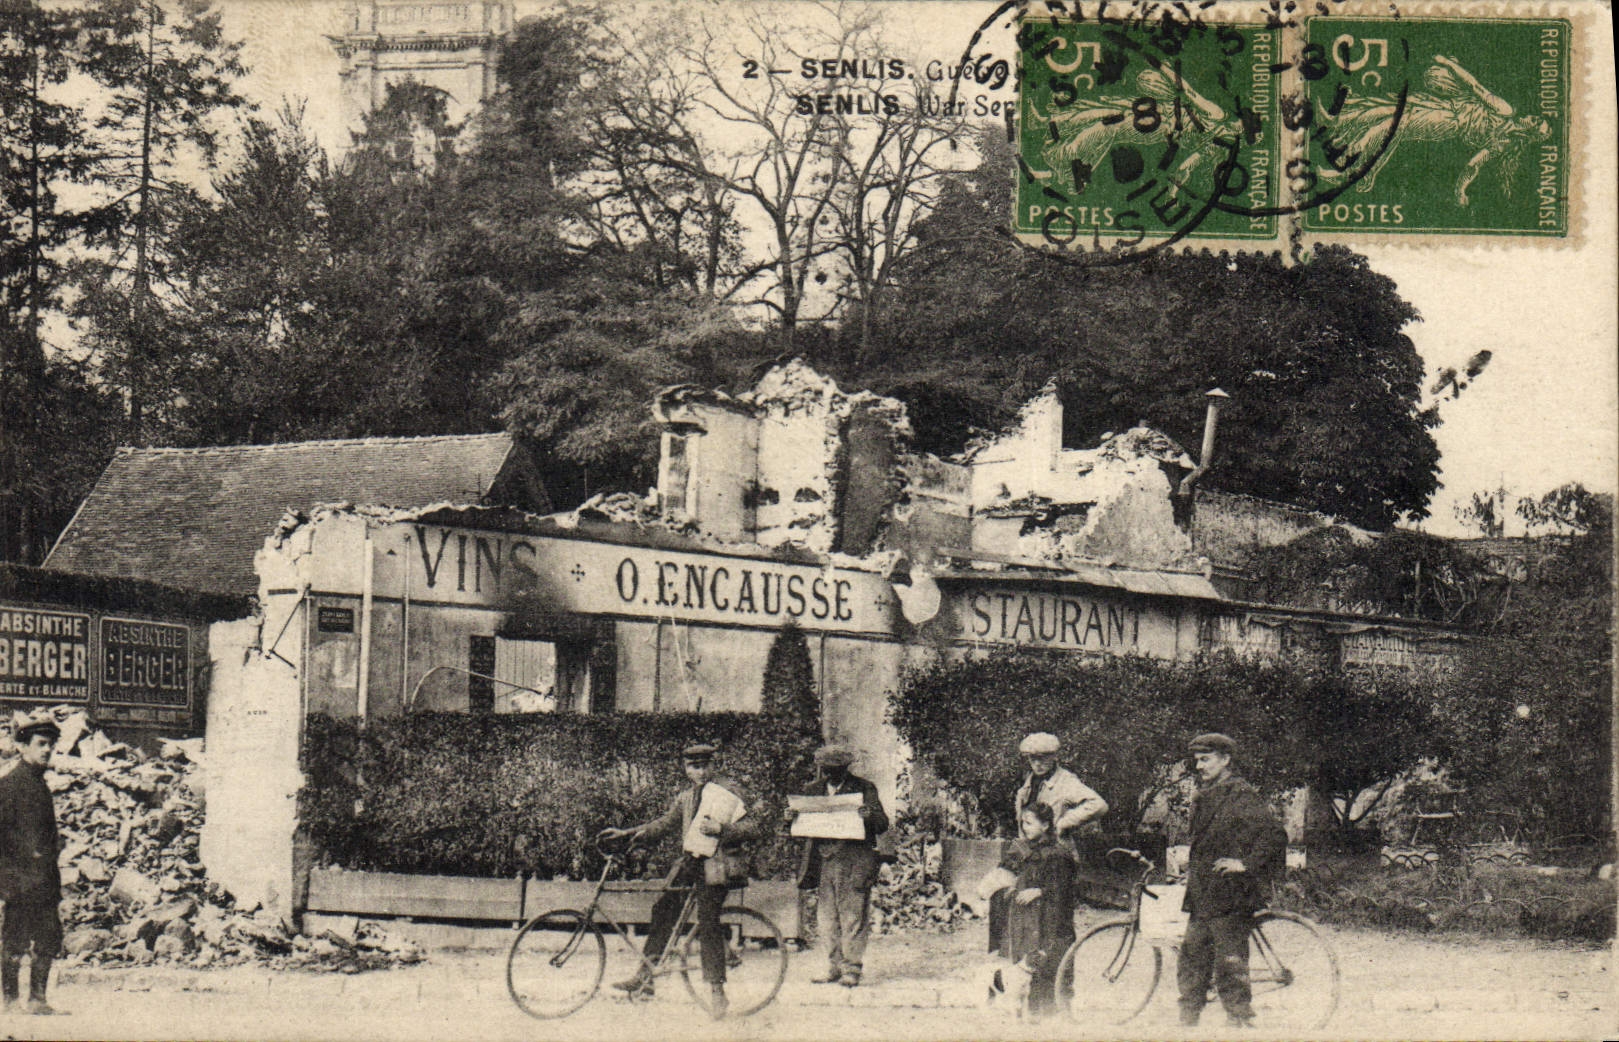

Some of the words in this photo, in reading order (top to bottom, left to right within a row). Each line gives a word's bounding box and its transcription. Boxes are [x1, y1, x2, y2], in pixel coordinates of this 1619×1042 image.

[1332, 34, 1388, 71] 5
[1540, 28, 1559, 119] REPUBLIQUE
[1250, 149, 1269, 231] FRANÇASE
[1536, 146, 1557, 227] FRANÇAISE
[1028, 204, 1115, 227] POSTES
[1318, 203, 1404, 224] POSTES
[414, 525, 539, 594] VINS
[0, 612, 83, 637] ABSINTHE
[108, 621, 185, 648] ABSINTHE
[971, 591, 1148, 648] STAURANT
[0, 638, 86, 680] BERGER
[103, 647, 184, 690] BERGER
[0, 682, 25, 696] ERTE
[43, 684, 88, 698] BLANCHE
